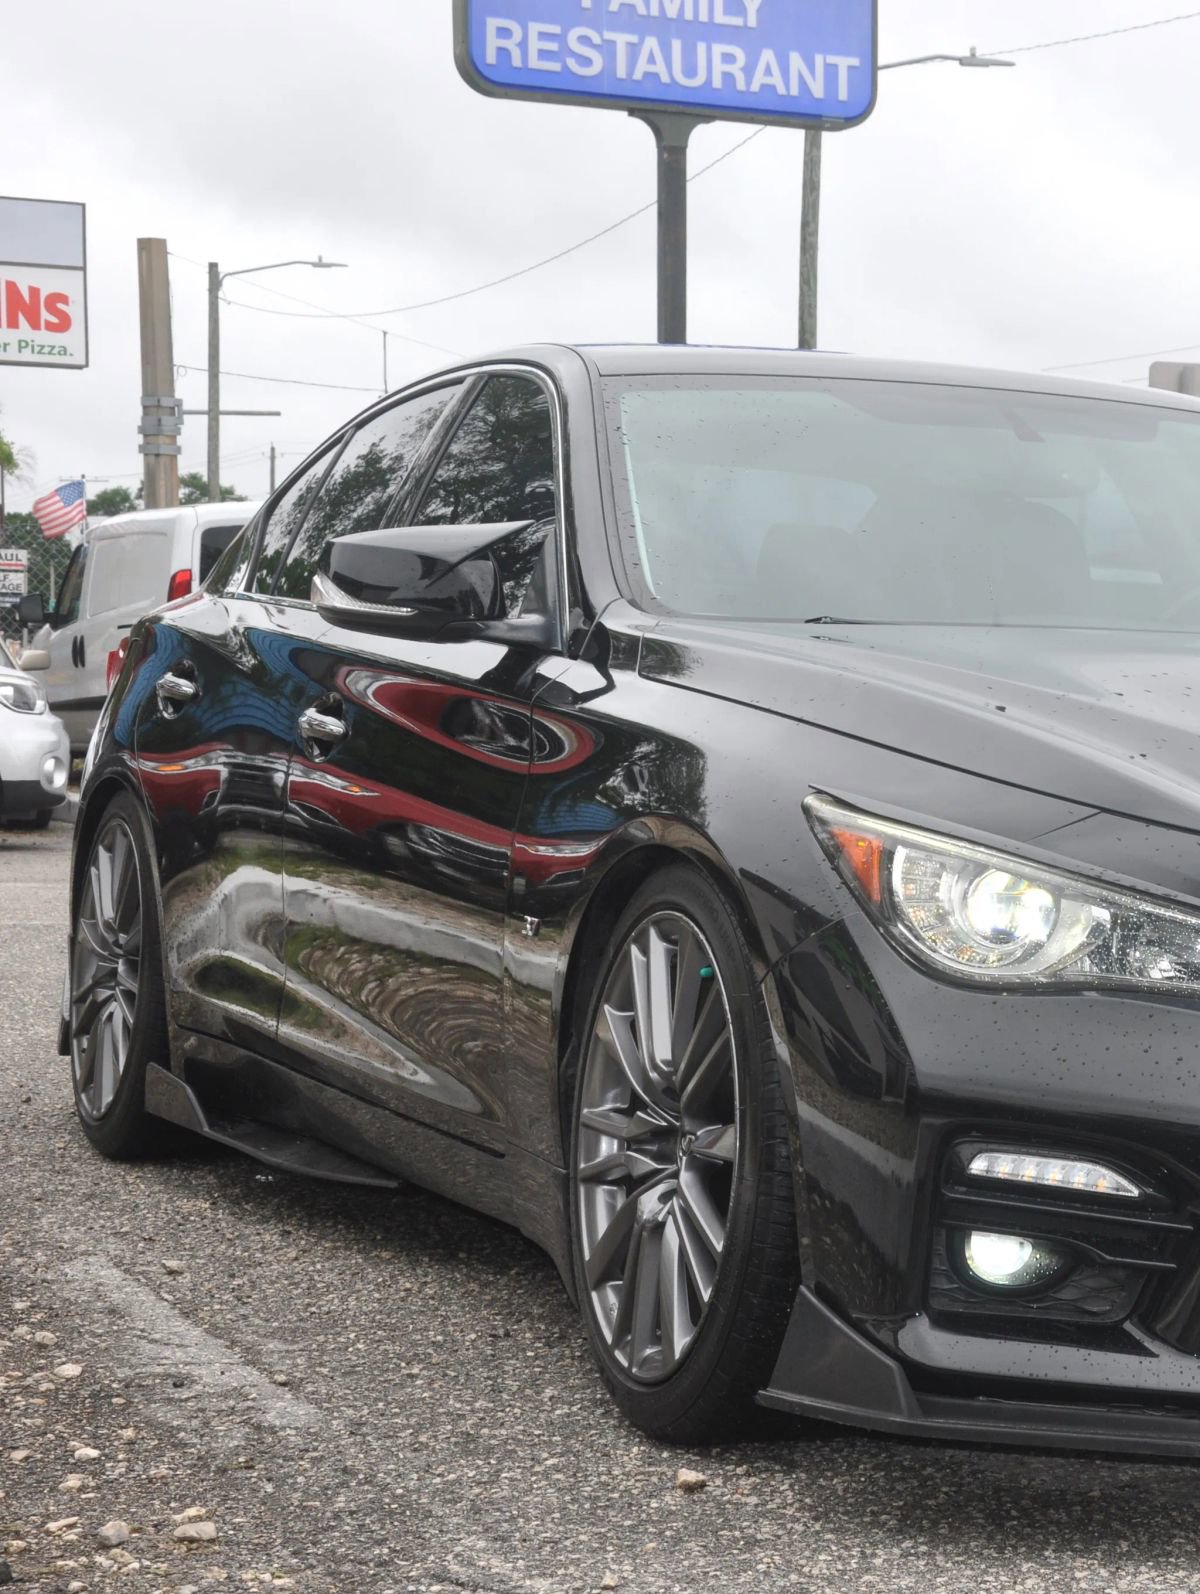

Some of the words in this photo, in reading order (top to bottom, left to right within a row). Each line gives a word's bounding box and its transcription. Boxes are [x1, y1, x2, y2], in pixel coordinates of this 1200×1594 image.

[580, 0, 764, 28] ILY
[485, 17, 861, 102] RESTAURANT
[0, 279, 72, 333] NS
[0, 342, 11, 353] r
[17, 339, 74, 357] Pizza.
